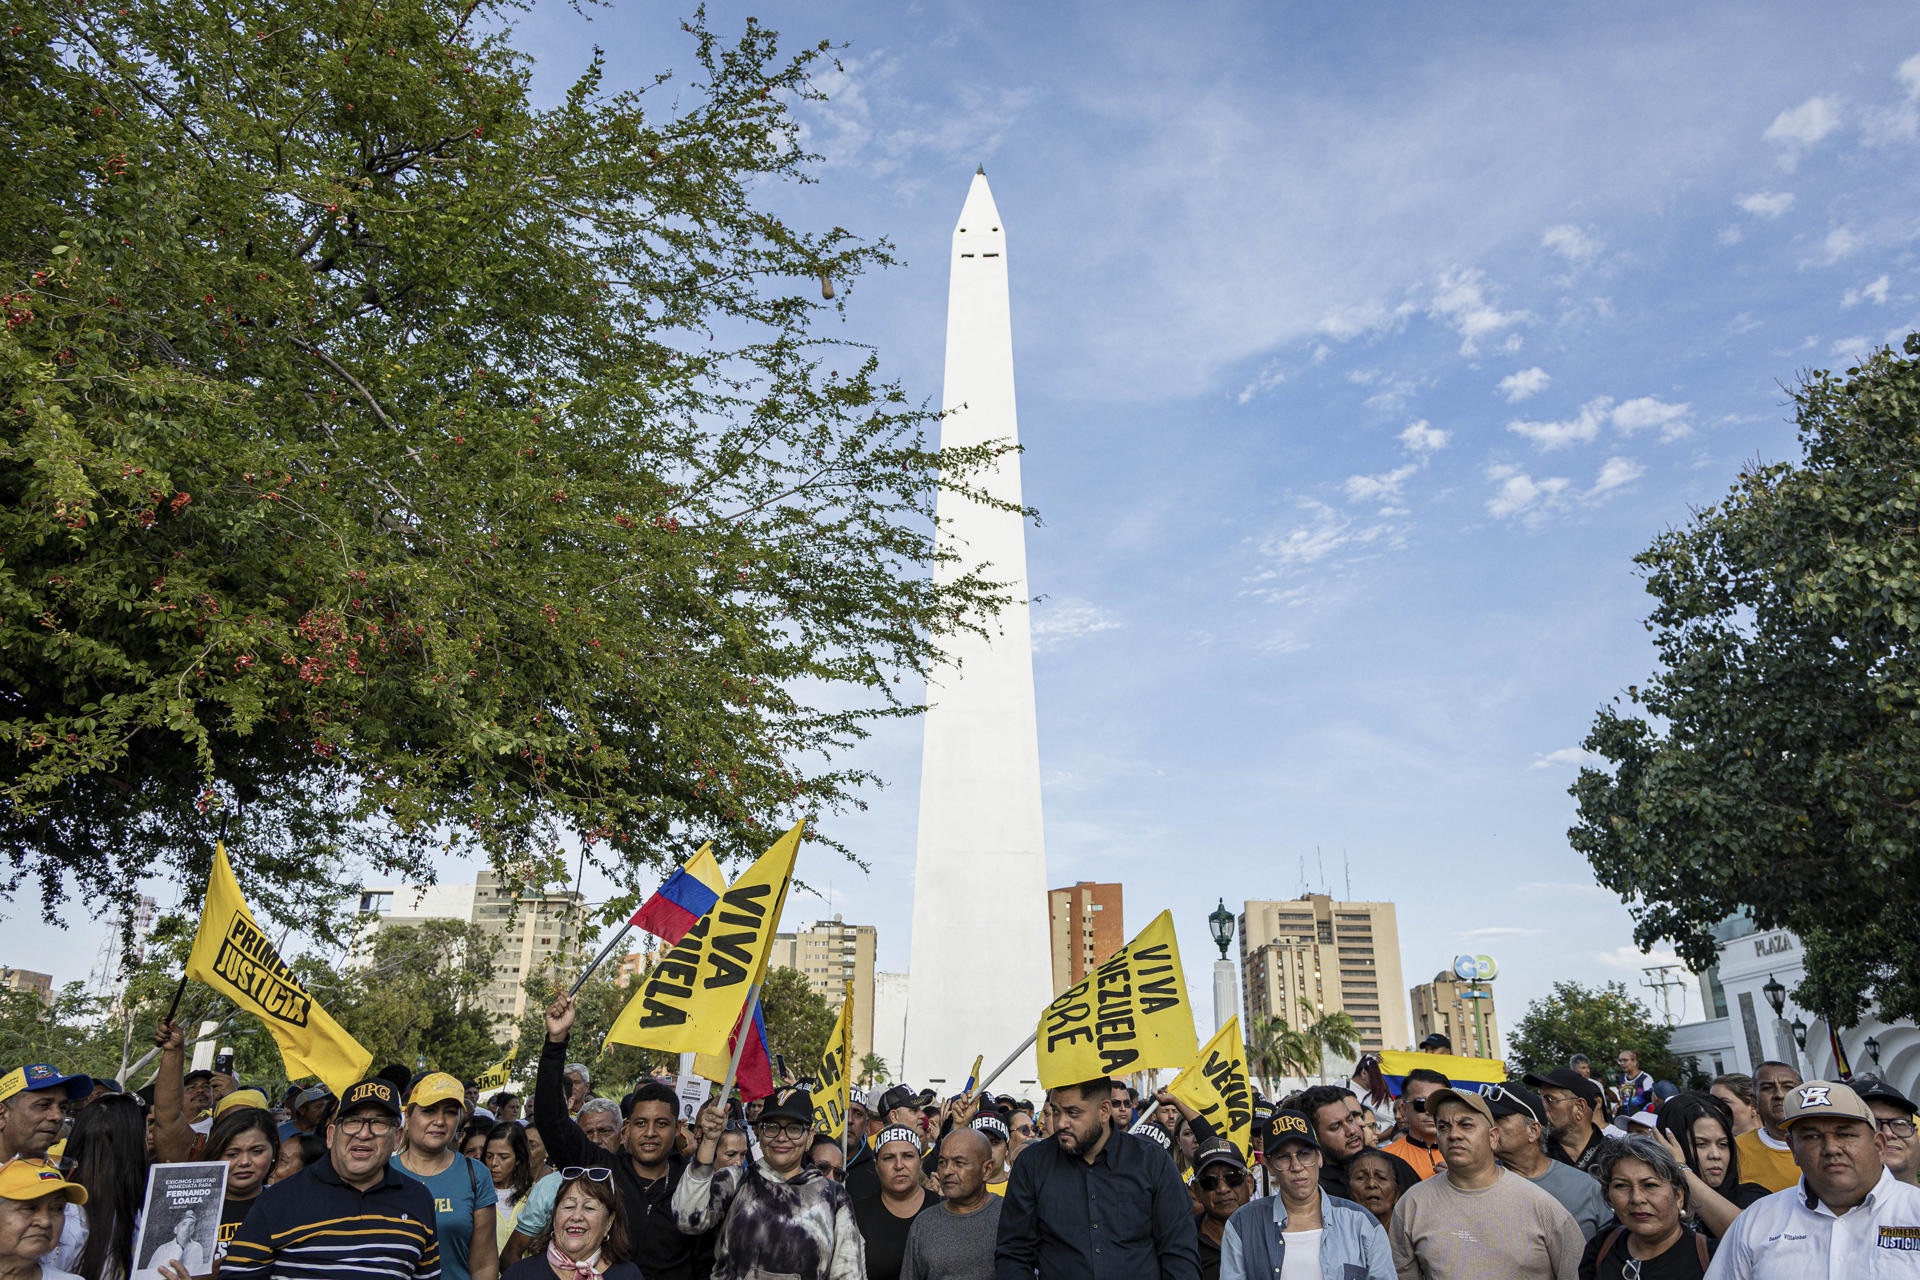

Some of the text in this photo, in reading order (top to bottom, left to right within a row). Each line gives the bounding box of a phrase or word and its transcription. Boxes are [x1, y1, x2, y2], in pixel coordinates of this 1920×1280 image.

[703, 883, 772, 990] VIVA
[1754, 933, 1793, 957] PLAZA
[217, 942, 306, 1024] JUSTICIA
[1132, 943, 1180, 1015] VIVA
[1046, 981, 1094, 1054] BRE
[351, 1082, 391, 1102] JPG
[1272, 1115, 1308, 1136] JPG
[166, 1189, 211, 1198] FERNANDO
[172, 1197, 203, 1205] LOAIZA
[1878, 1236, 1920, 1251] JUSTICIA
